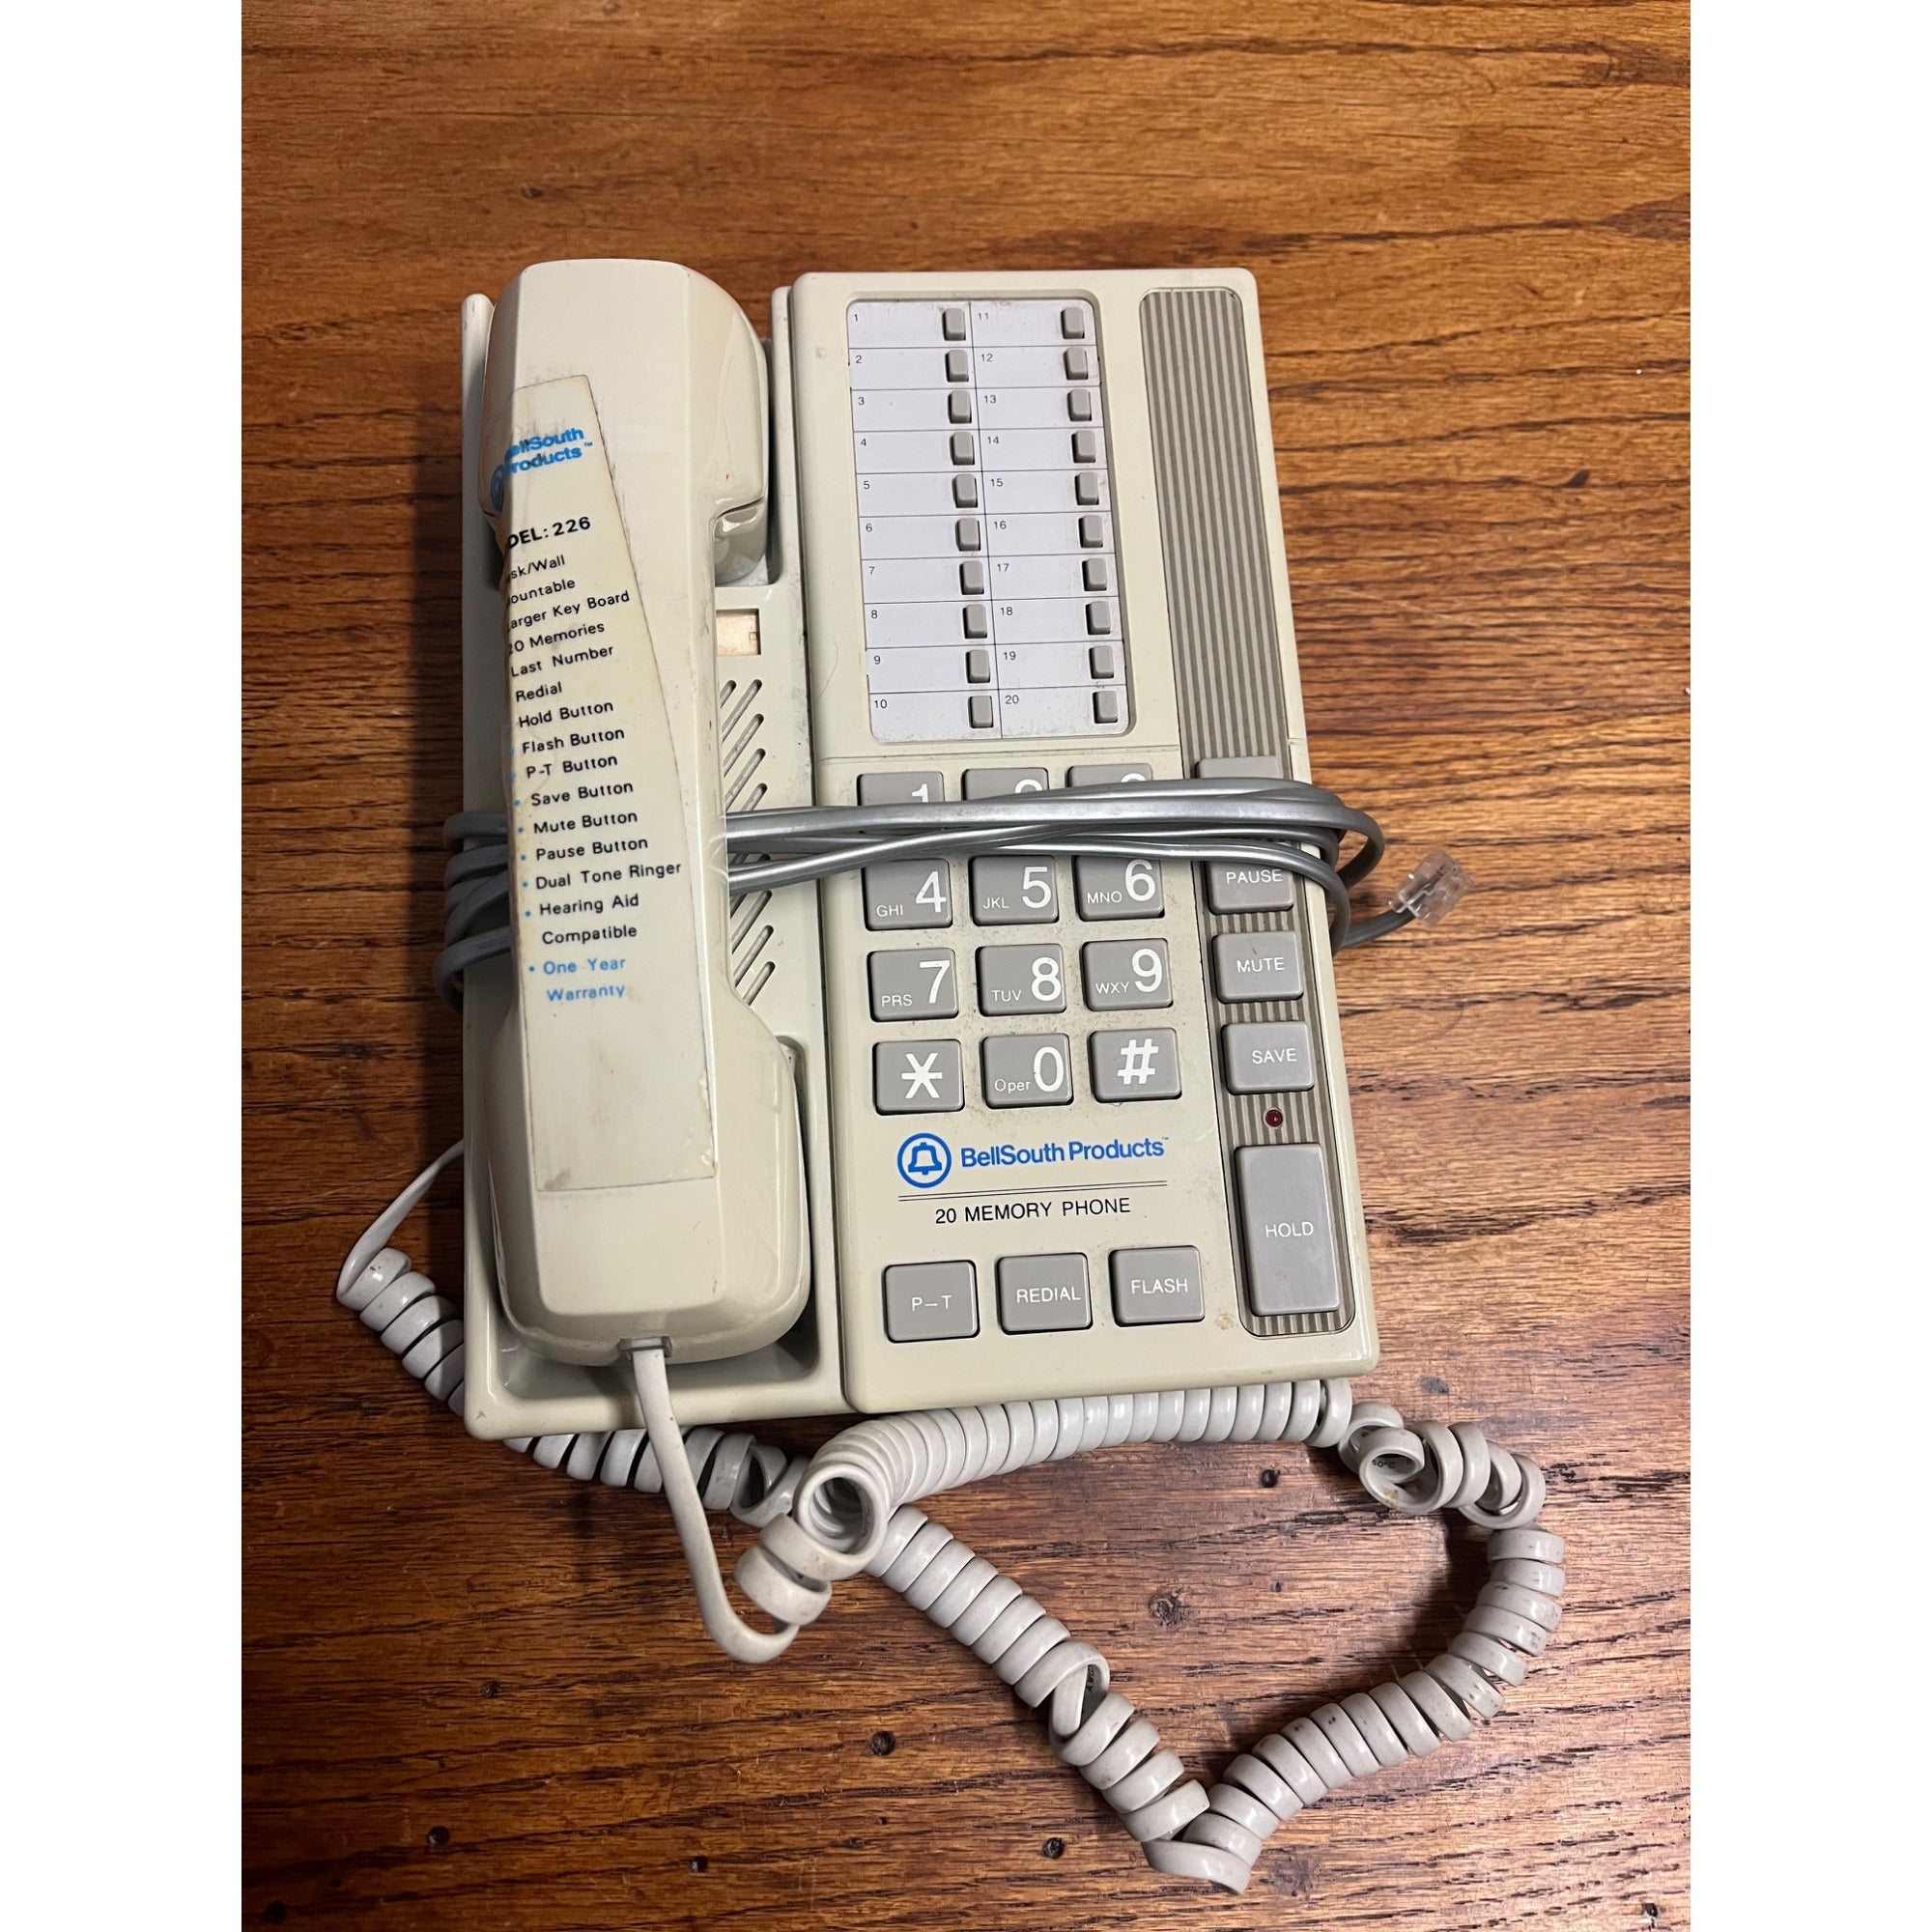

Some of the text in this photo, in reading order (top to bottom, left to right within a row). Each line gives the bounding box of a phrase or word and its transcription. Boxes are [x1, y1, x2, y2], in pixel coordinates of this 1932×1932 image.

[980, 354, 993, 362] 12
[984, 395, 997, 404] 13
[505, 428, 583, 461] ellSouth
[503, 447, 582, 475] roducts
[991, 478, 1004, 487] 15
[507, 517, 591, 549] DEL: 226
[994, 521, 1007, 529] 16
[508, 554, 565, 581] sk/Wall
[997, 563, 1009, 572] 17
[508, 579, 576, 605] ountable
[509, 590, 631, 628] arger Key Board
[1000, 607, 1013, 615] 18
[529, 623, 605, 648] Memories
[511, 645, 613, 677] Last Number
[1004, 652, 1016, 661] 19
[516, 681, 562, 702] Redial
[1005, 696, 1019, 705] 20
[519, 702, 613, 727] Hold Button
[874, 699, 888, 709] 10
[523, 728, 625, 753] Flash Button
[526, 755, 618, 779] P-T Button
[531, 782, 634, 807] Save Button
[533, 812, 638, 834] Mute Button
[536, 838, 648, 861] Pause Button
[536, 864, 681, 889] Dual Tone Ringer
[1087, 859, 1156, 904] MNO 6
[1226, 869, 1283, 885] PAUSE
[876, 871, 947, 918] GHI 4
[982, 867, 1052, 910] JKL 5
[539, 893, 639, 916] Hearing Aid
[542, 925, 638, 945] Compatible
[543, 957, 626, 975] One Year
[1095, 948, 1162, 994] WXY 9
[1236, 957, 1286, 974] MUTE
[882, 960, 951, 1008] PRS 7
[991, 956, 1062, 1002] TUV 8
[547, 985, 625, 1002] Warranty
[1252, 1048, 1296, 1065] SAVE
[994, 1046, 1064, 1094] Oper 0
[960, 1143, 1065, 1168] BellSouth
[935, 1198, 1131, 1224] 20 MEMORY PHONE
[1264, 1221, 1314, 1238] HOLD
[1016, 1287, 1081, 1303] REDIAL
[1131, 1278, 1188, 1294] FLASH
